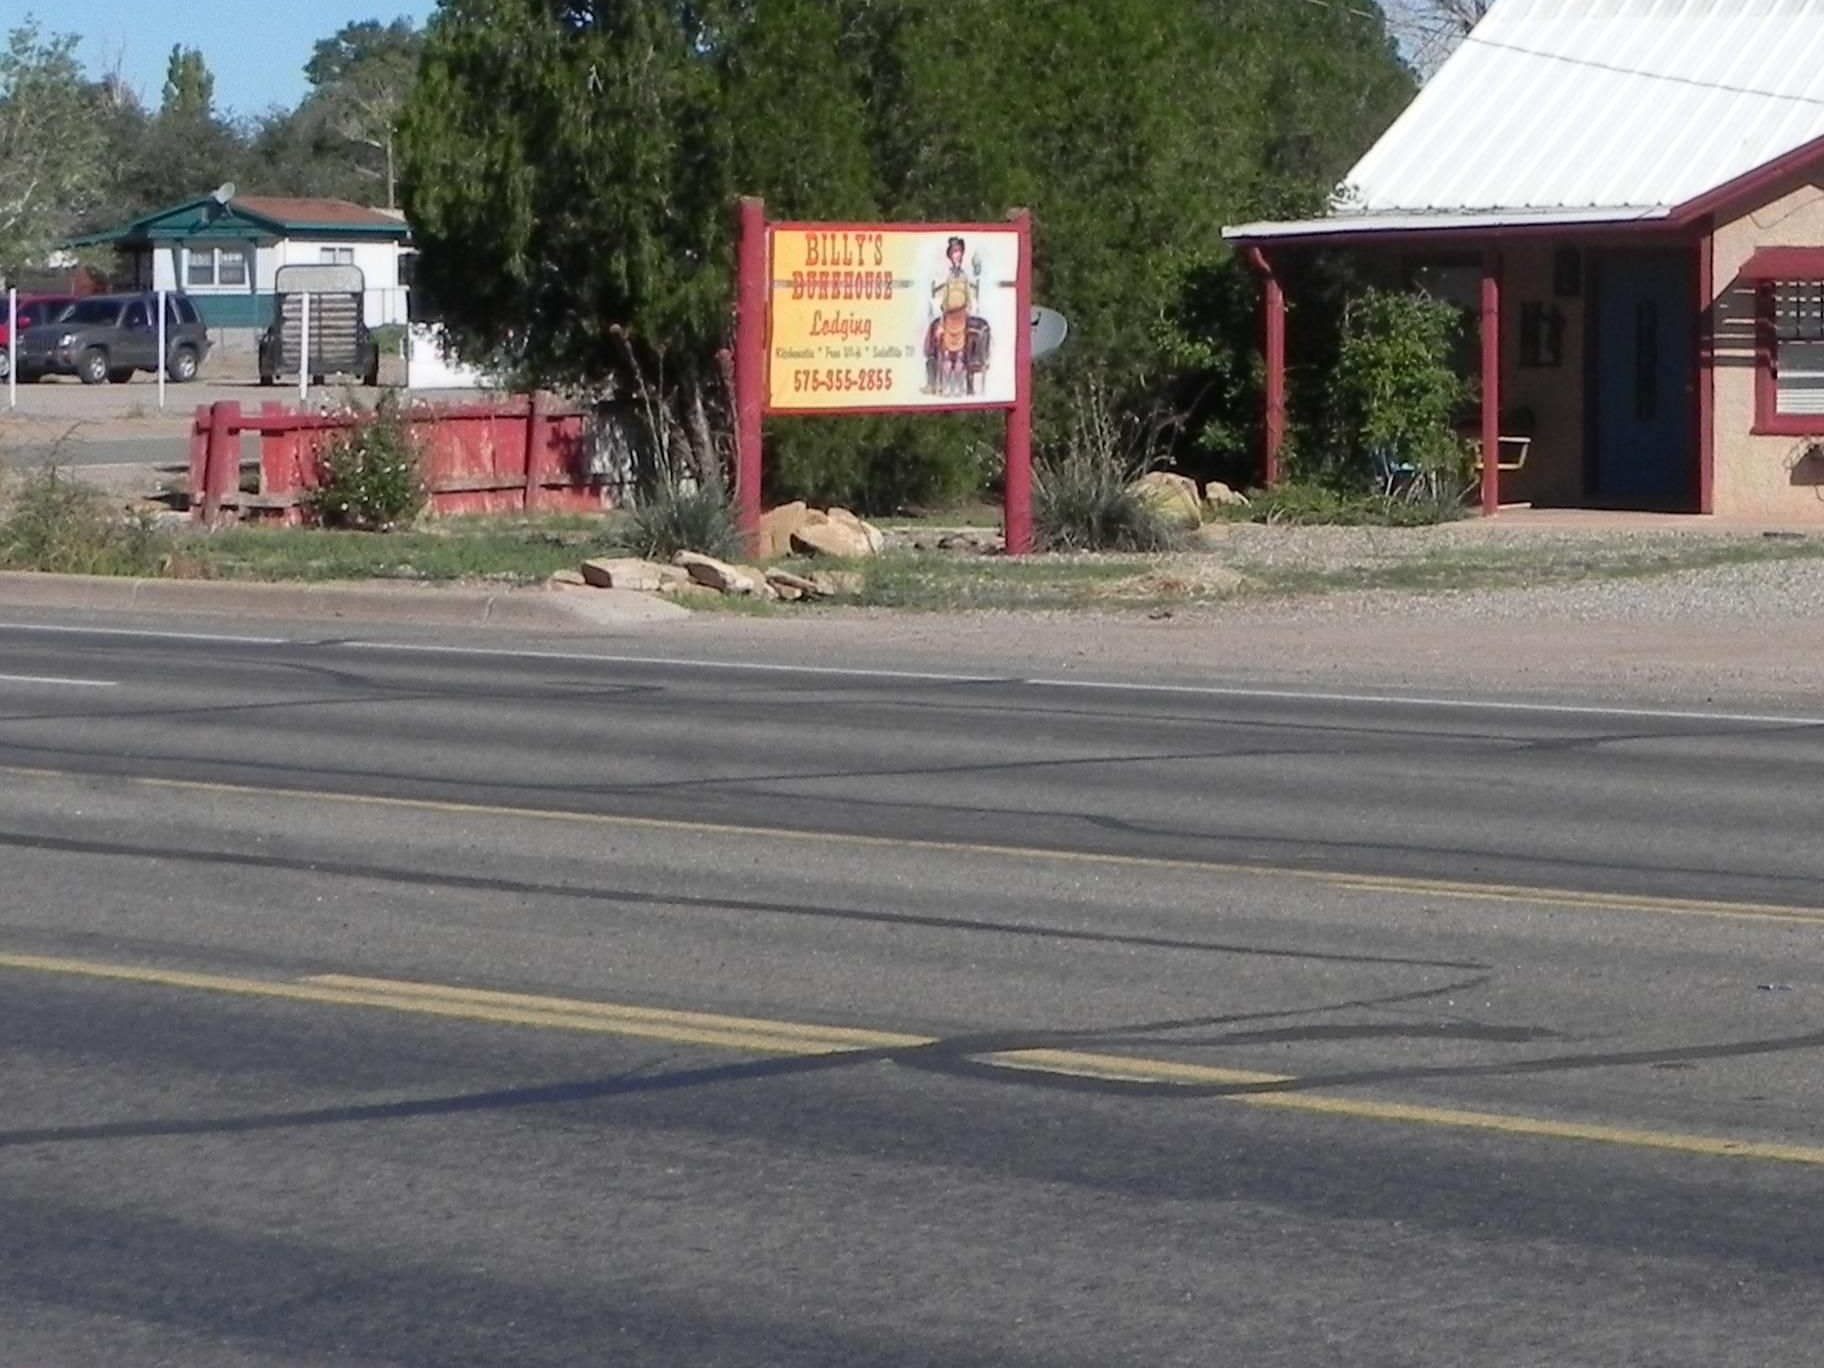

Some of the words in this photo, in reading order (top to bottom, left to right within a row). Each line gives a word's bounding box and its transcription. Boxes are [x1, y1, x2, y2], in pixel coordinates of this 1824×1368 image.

[805, 233, 883, 266] BILLY'S
[792, 271, 893, 300] BUNKHOUSE
[809, 310, 872, 341] Lodging
[794, 368, 893, 392] 575-355-2855
